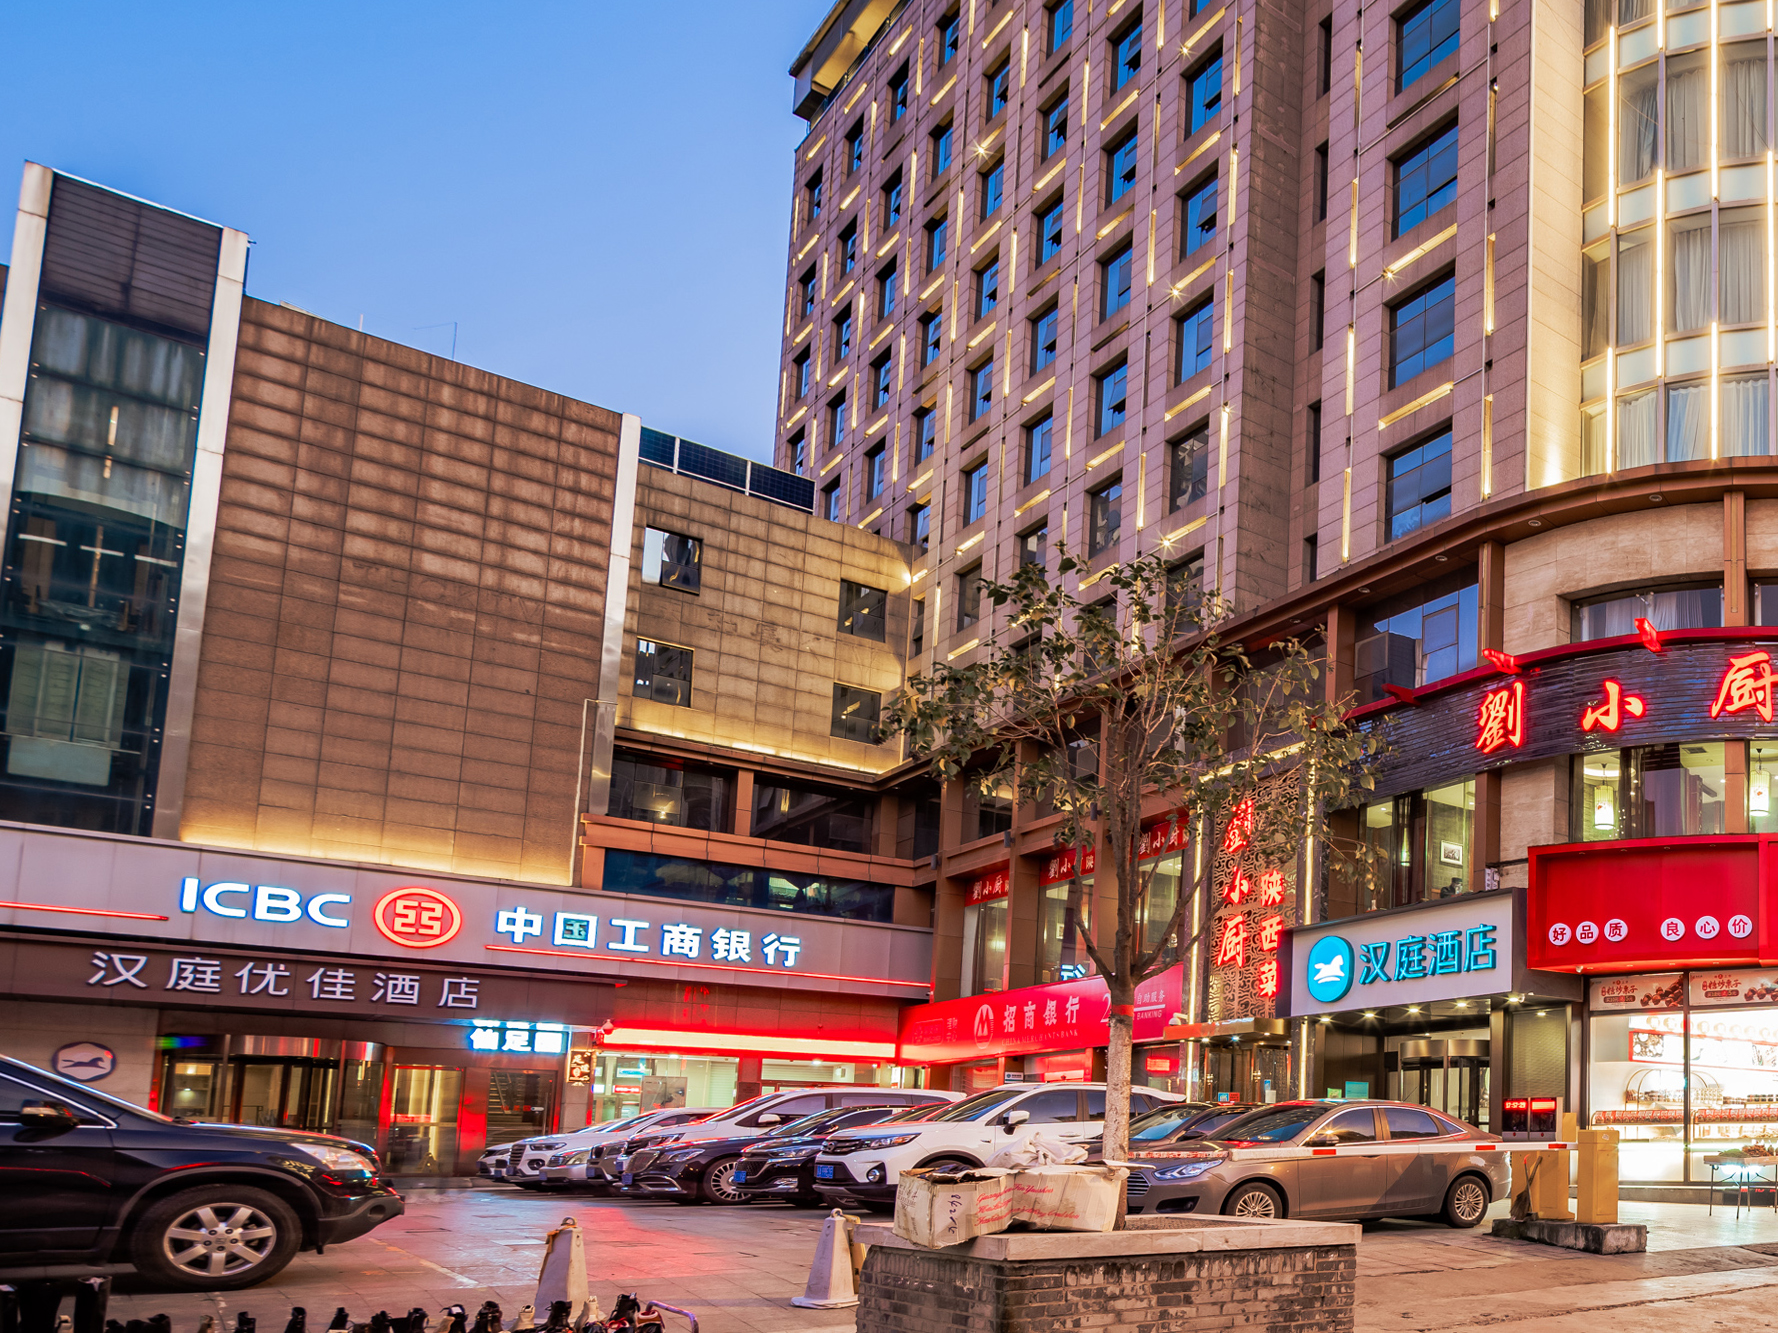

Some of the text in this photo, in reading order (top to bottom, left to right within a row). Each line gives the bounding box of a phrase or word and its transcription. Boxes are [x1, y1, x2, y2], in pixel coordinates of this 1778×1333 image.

[180, 877, 350, 928] ICBC
[1551, 917, 1750, 944] 好品质 良心价
[496, 906, 801, 967] 中国工商银行
[1259, 869, 1284, 997] 陕西菜
[1359, 923, 1497, 985] 汉庭酒店
[88, 951, 481, 1009] 汉庭优佳酒店
[1002, 995, 1080, 1033] 招商银行
